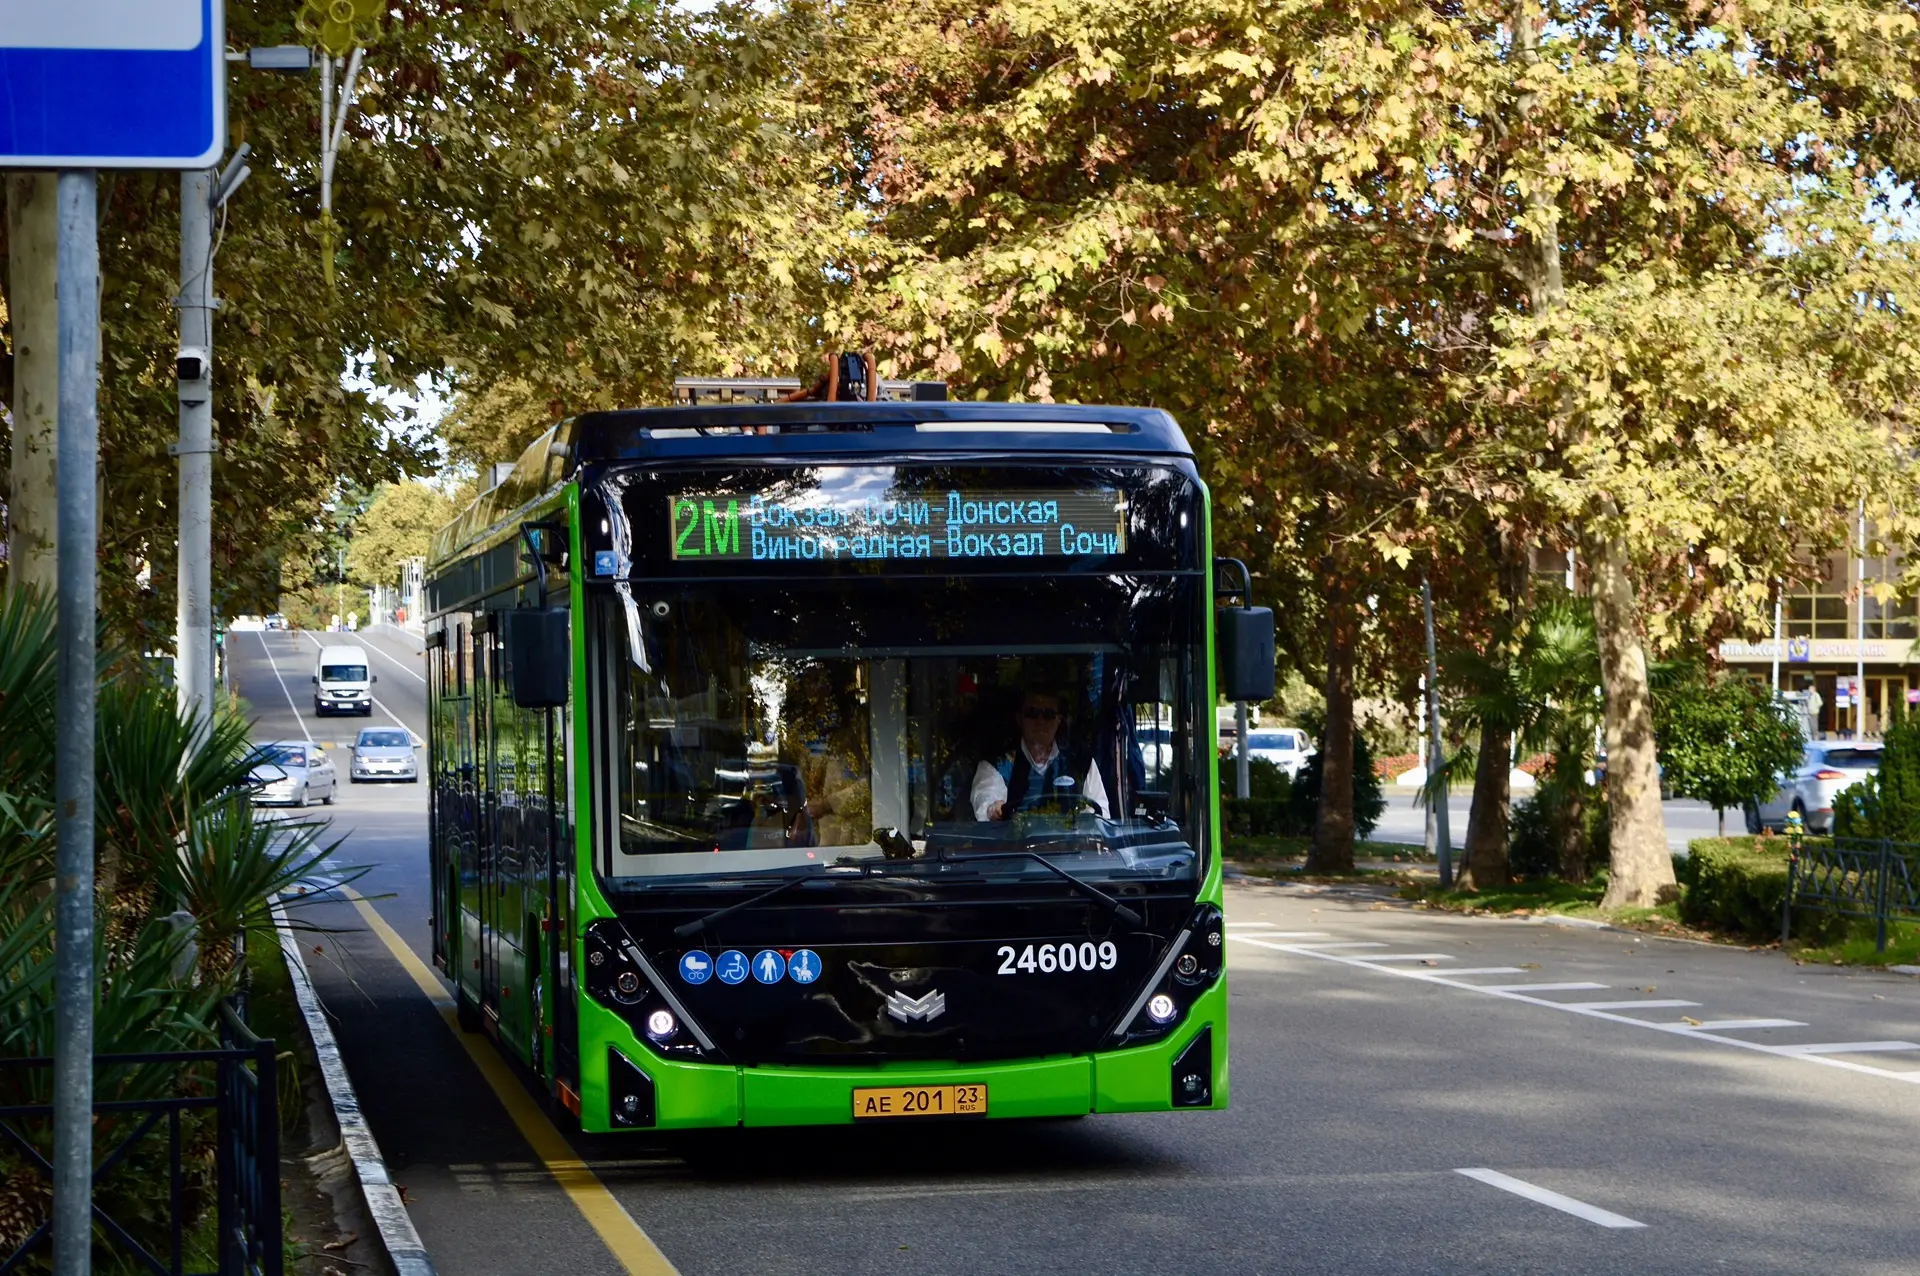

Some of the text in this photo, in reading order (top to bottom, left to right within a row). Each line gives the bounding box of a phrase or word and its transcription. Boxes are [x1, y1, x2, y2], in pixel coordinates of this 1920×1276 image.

[1060, 523, 1123, 555] Сочи
[996, 941, 1118, 975] 246009
[902, 1089, 943, 1112] 201
[957, 1087, 979, 1104] 23
